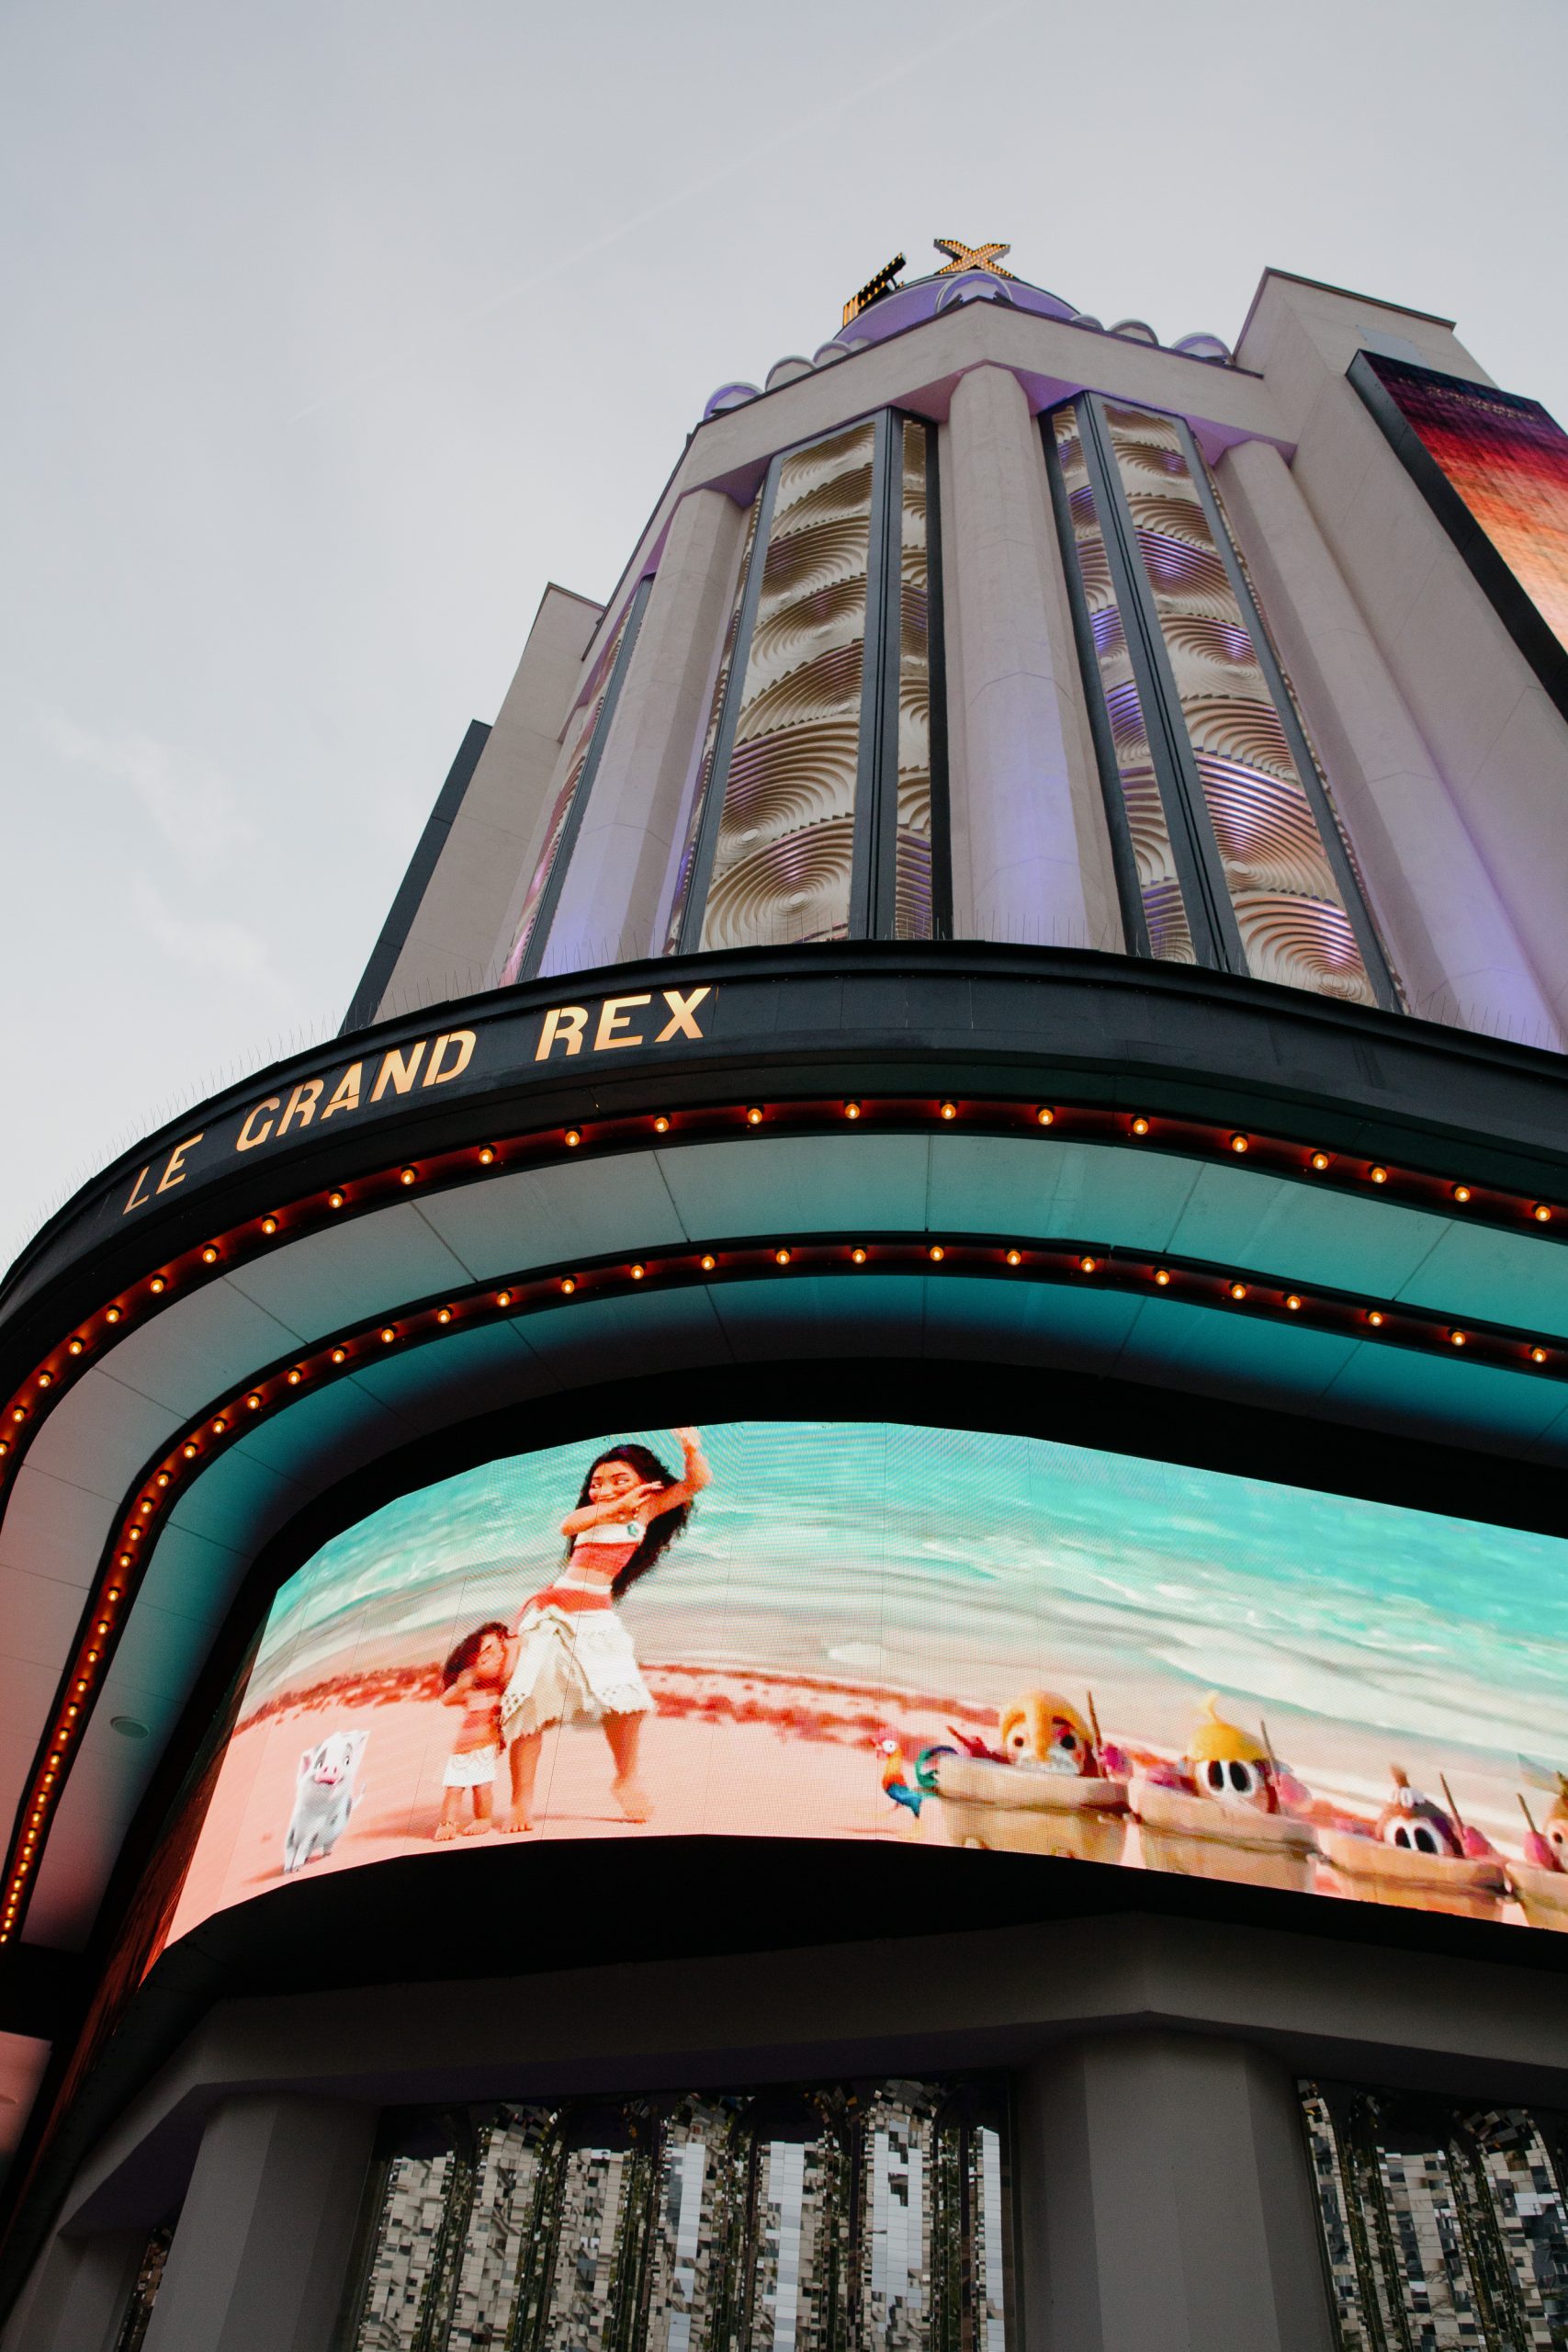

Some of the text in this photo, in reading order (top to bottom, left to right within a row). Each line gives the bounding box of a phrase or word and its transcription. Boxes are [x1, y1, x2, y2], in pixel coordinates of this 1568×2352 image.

[933, 238, 1017, 278] X
[122, 987, 712, 1216] LE GRAND REX
